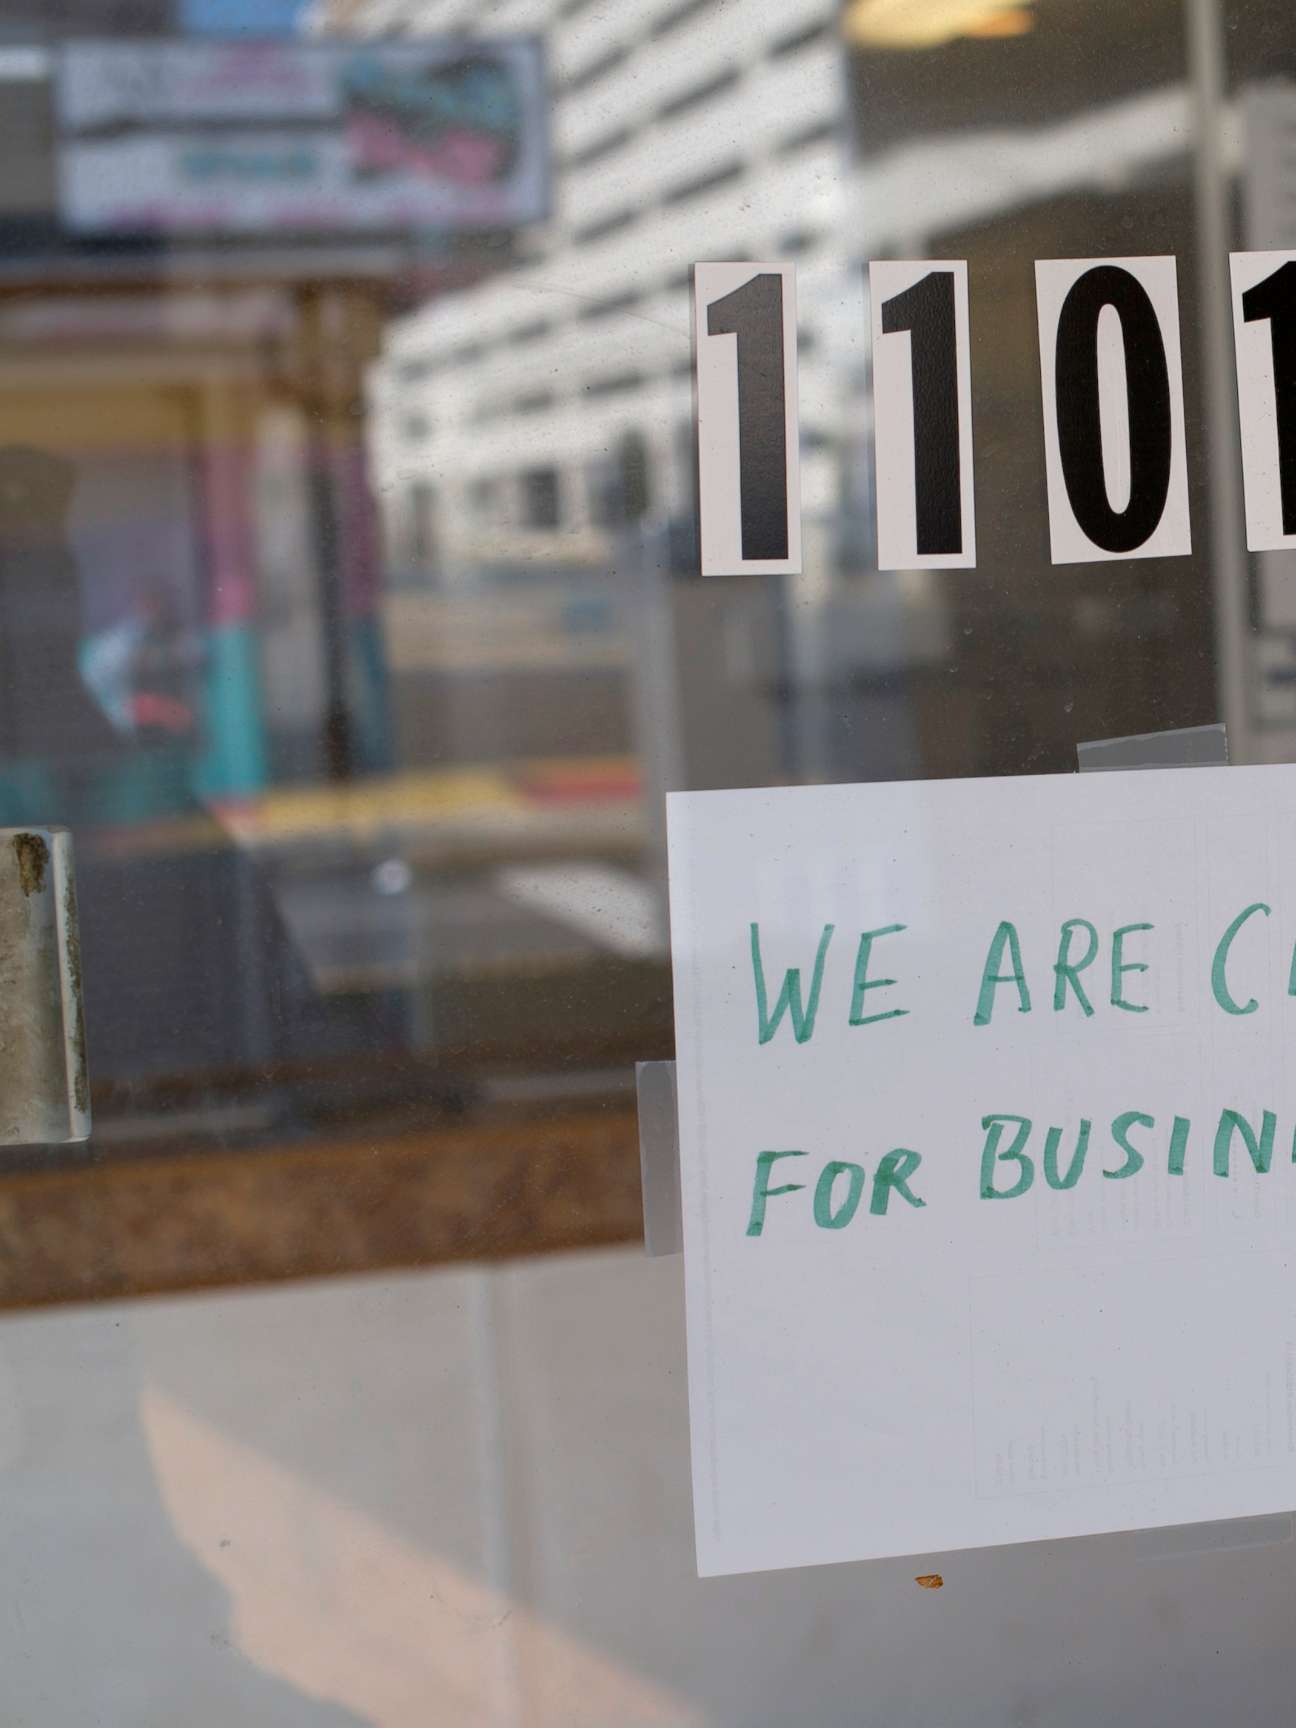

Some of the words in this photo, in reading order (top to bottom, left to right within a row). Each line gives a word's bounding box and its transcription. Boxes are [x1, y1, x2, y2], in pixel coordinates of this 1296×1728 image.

[751, 922, 909, 1045] WE
[973, 919, 1155, 1026] ARE
[746, 1148, 927, 1237] FOR
